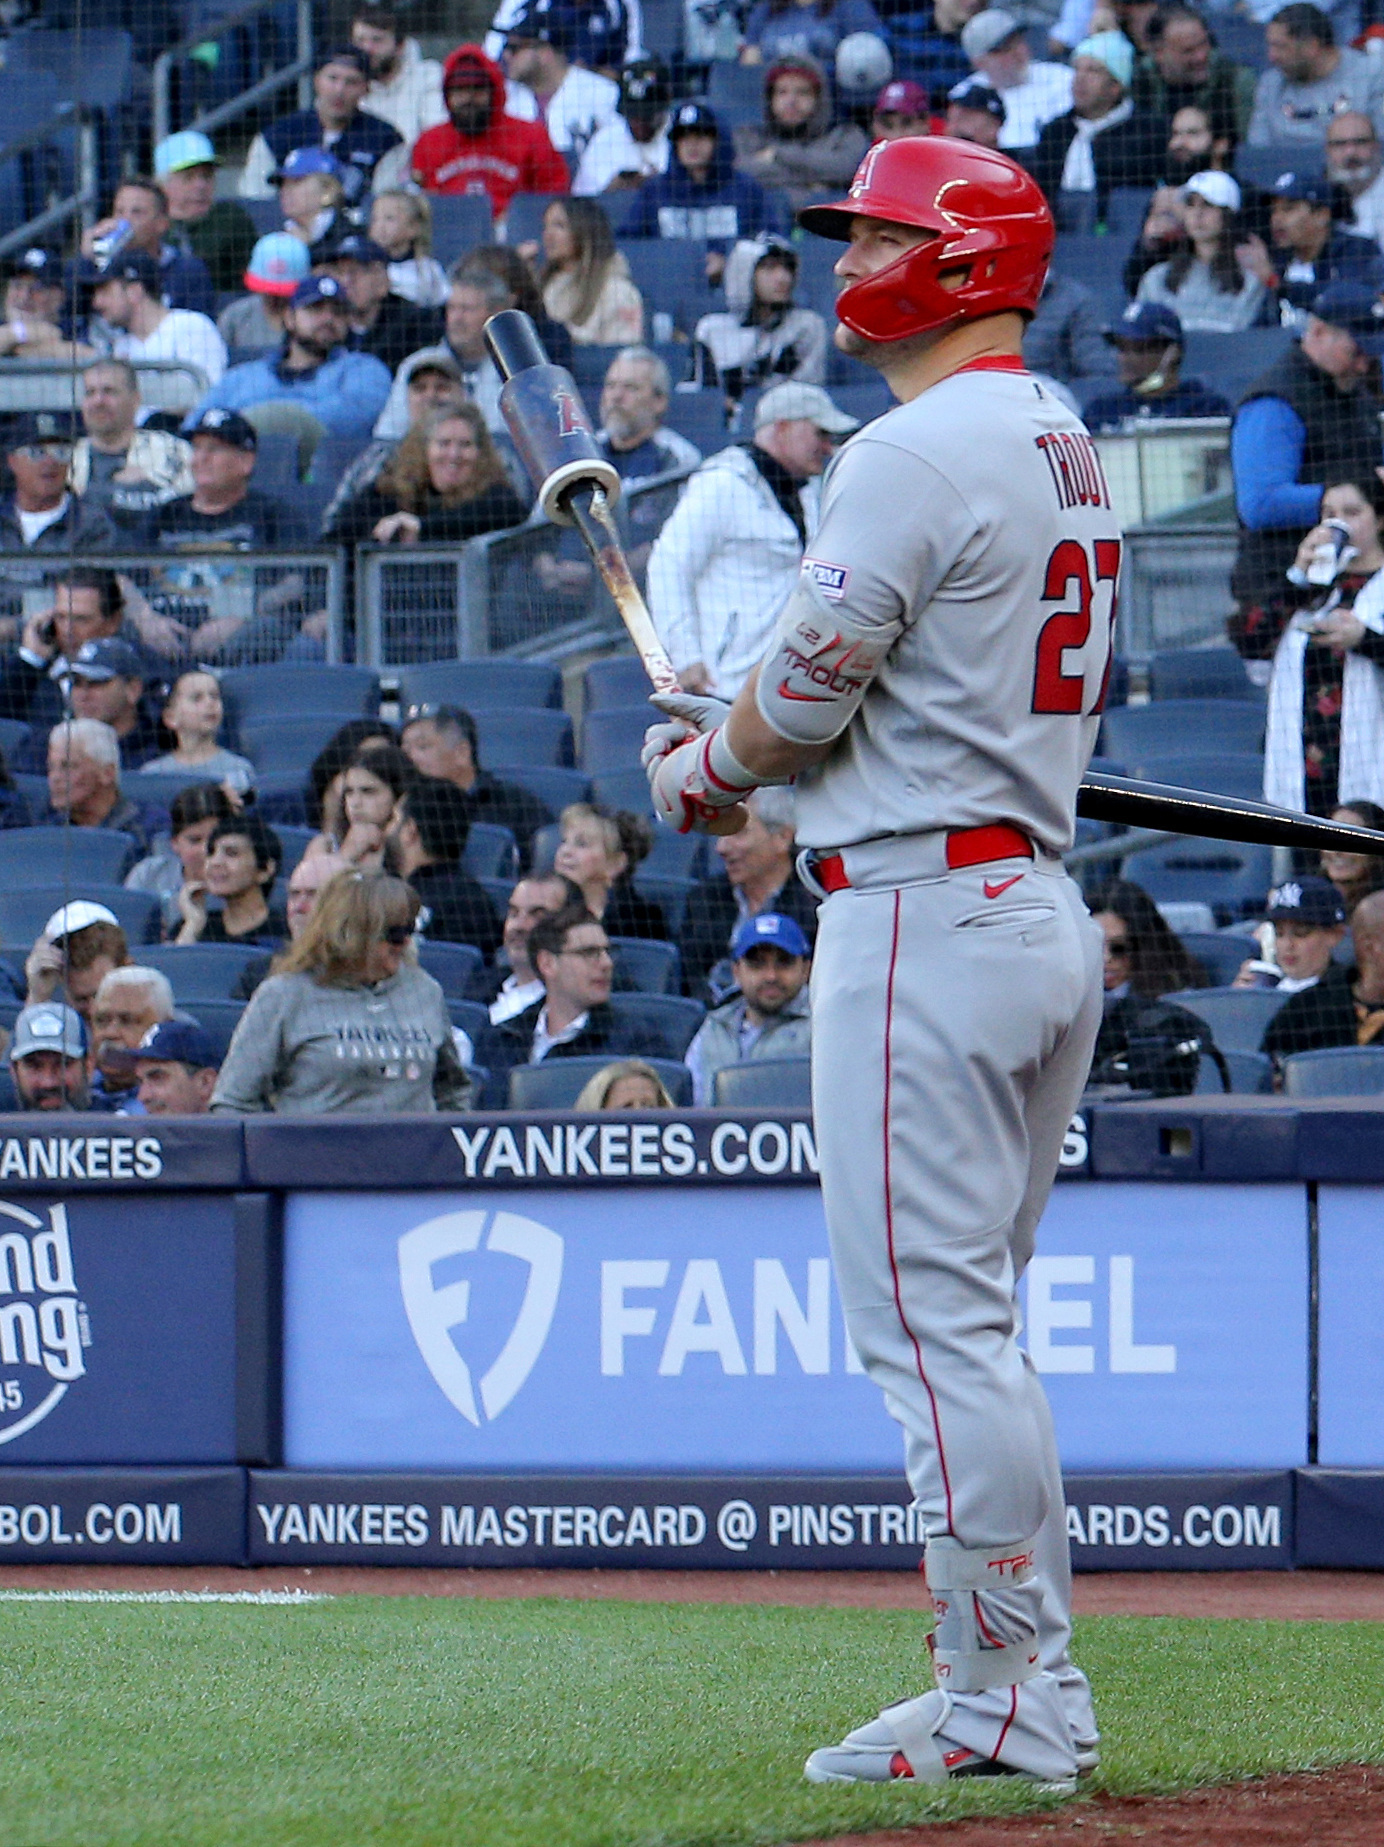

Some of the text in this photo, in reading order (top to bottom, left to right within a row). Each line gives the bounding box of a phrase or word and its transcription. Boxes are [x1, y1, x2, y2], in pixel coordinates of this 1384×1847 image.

[1035, 432, 1110, 510] TROUT
[1031, 539, 1122, 716] 27
[783, 647, 862, 696] TROUT
[0, 1138, 162, 1180] ANKEES
[602, 1256, 1177, 1376] FANEL
[257, 1504, 429, 1547] YANKEES
[440, 1504, 706, 1547] MASTERCARD
[717, 1500, 757, 1551] @
